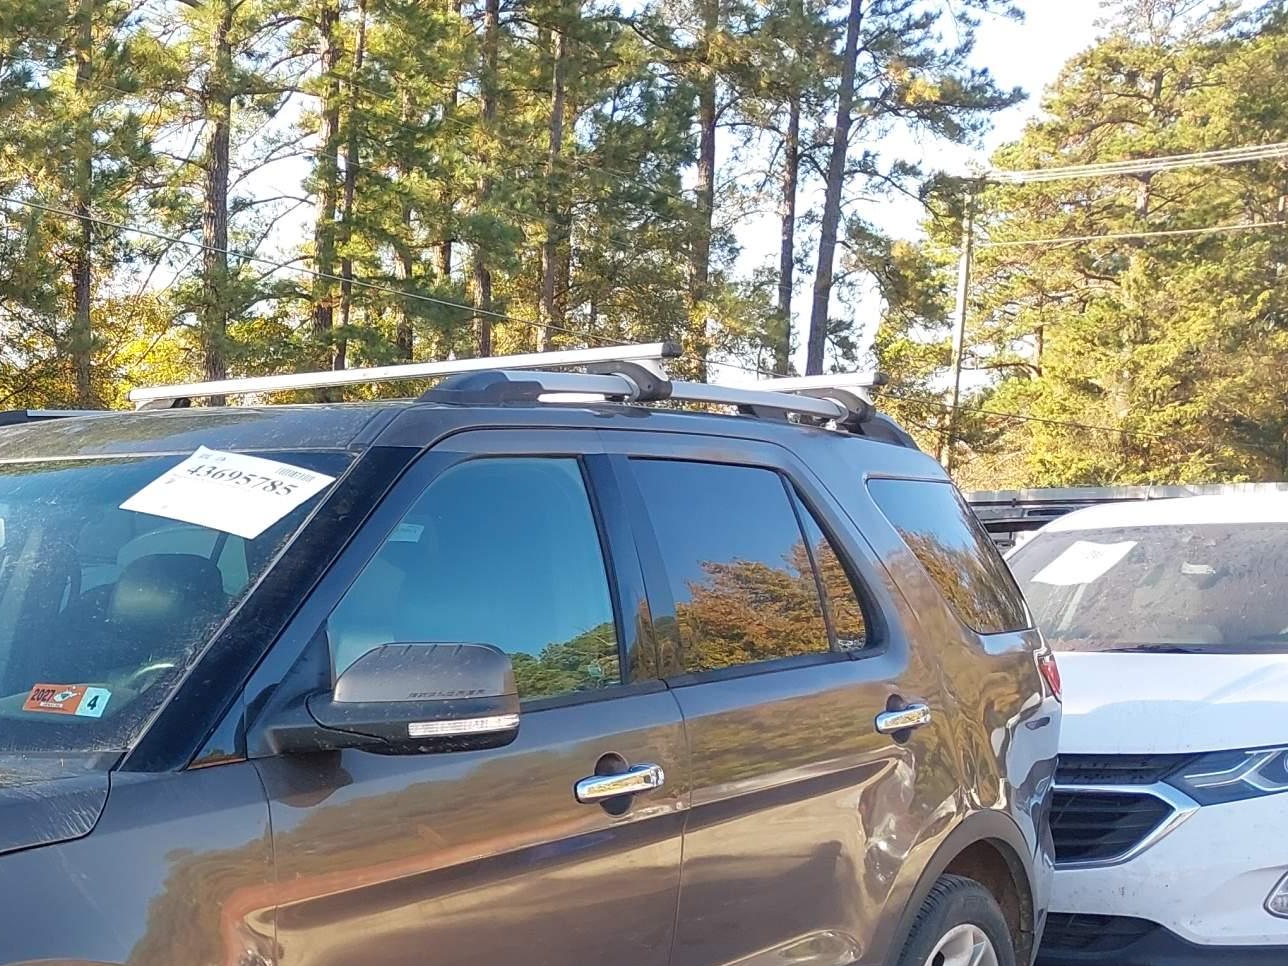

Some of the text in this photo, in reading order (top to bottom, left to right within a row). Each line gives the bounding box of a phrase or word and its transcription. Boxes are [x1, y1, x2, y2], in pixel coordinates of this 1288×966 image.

[187, 464, 299, 496] 43695785
[31, 688, 56, 702] 2027
[87, 695, 100, 711] 4
